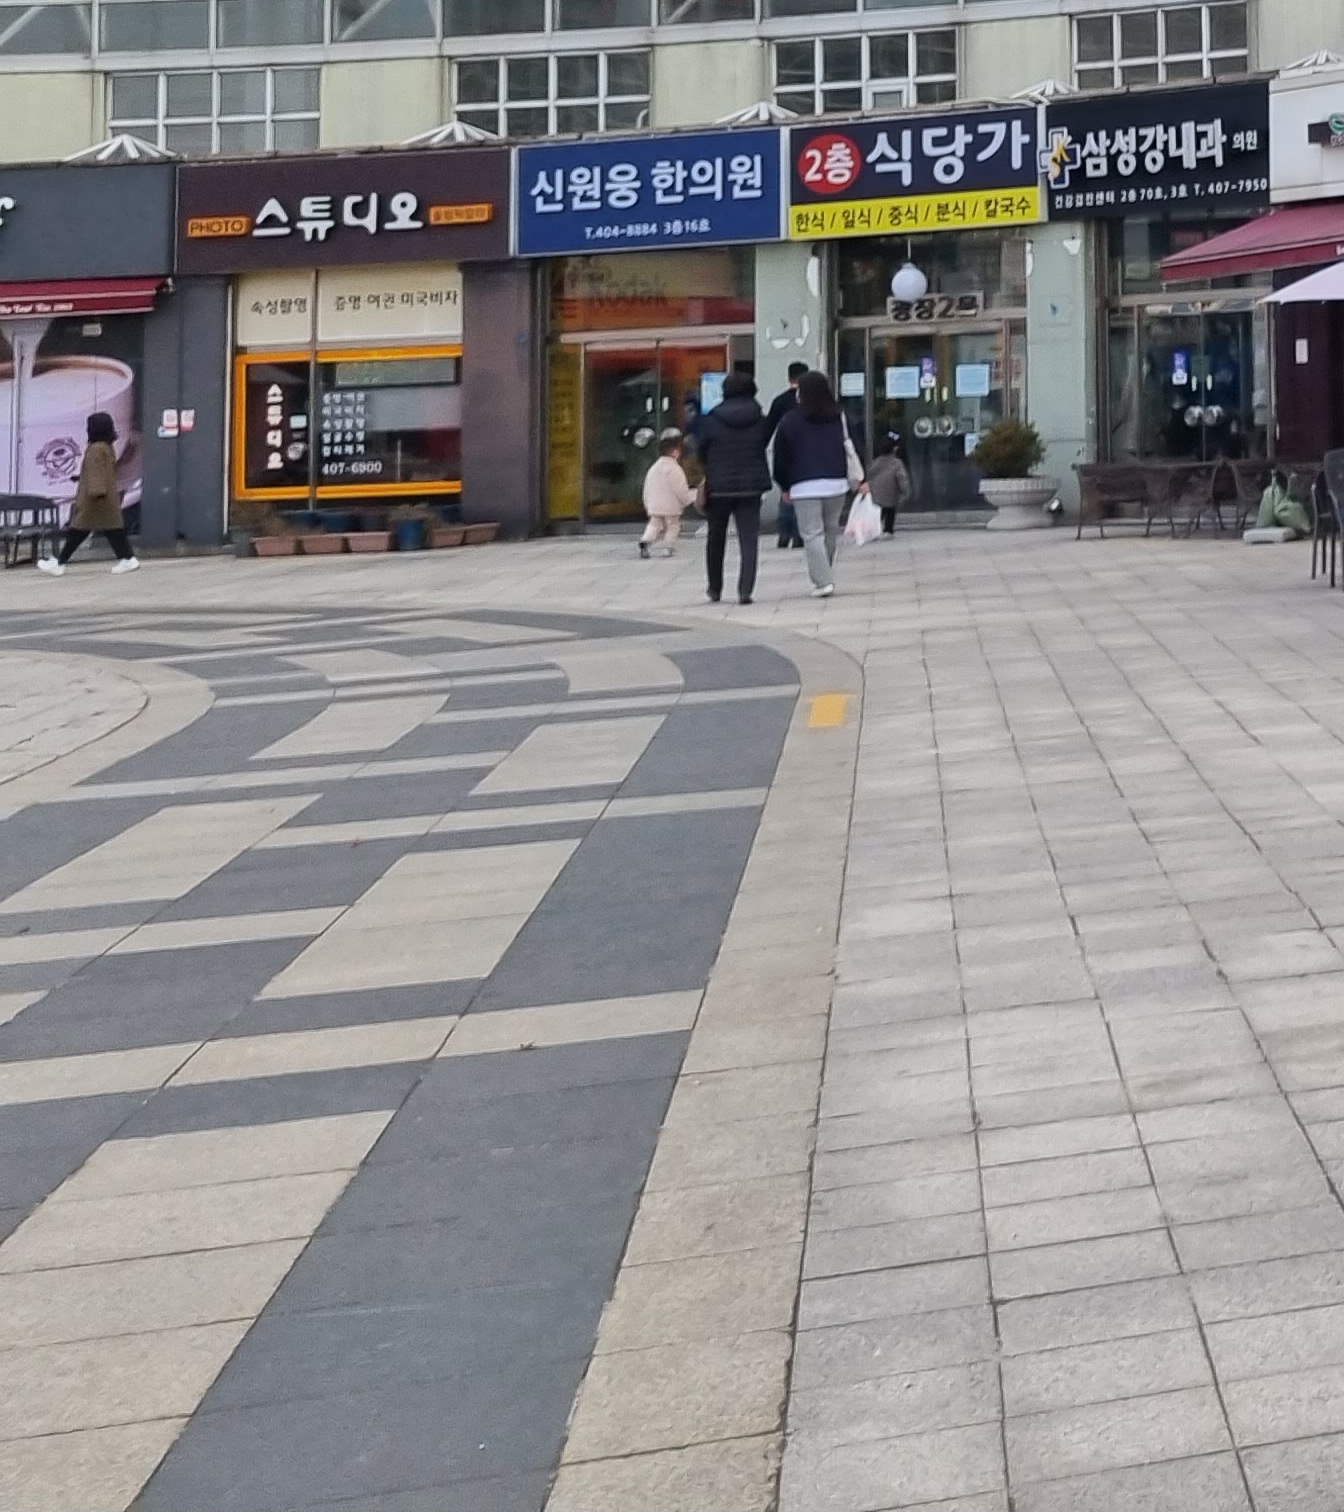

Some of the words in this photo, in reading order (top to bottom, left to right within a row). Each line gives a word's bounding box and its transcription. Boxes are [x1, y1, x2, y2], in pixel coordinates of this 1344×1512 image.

[804, 142, 854, 185] 2층
[866, 119, 1031, 188] 식당가
[1081, 117, 1227, 178] 삼성강내과
[1232, 130, 1258, 152] 의원
[530, 163, 642, 214] 신원웅
[651, 154, 763, 206] 한의원
[796, 210, 825, 233] 한식
[842, 208, 871, 230] 일식
[889, 204, 919, 226] 중식
[936, 200, 966, 222] 분식
[983, 195, 1032, 217] 칼국수
[191, 219, 244, 235] PHOTO
[252, 191, 424, 242] 스튜디오
[266, 383, 284, 470] 스튜디오
